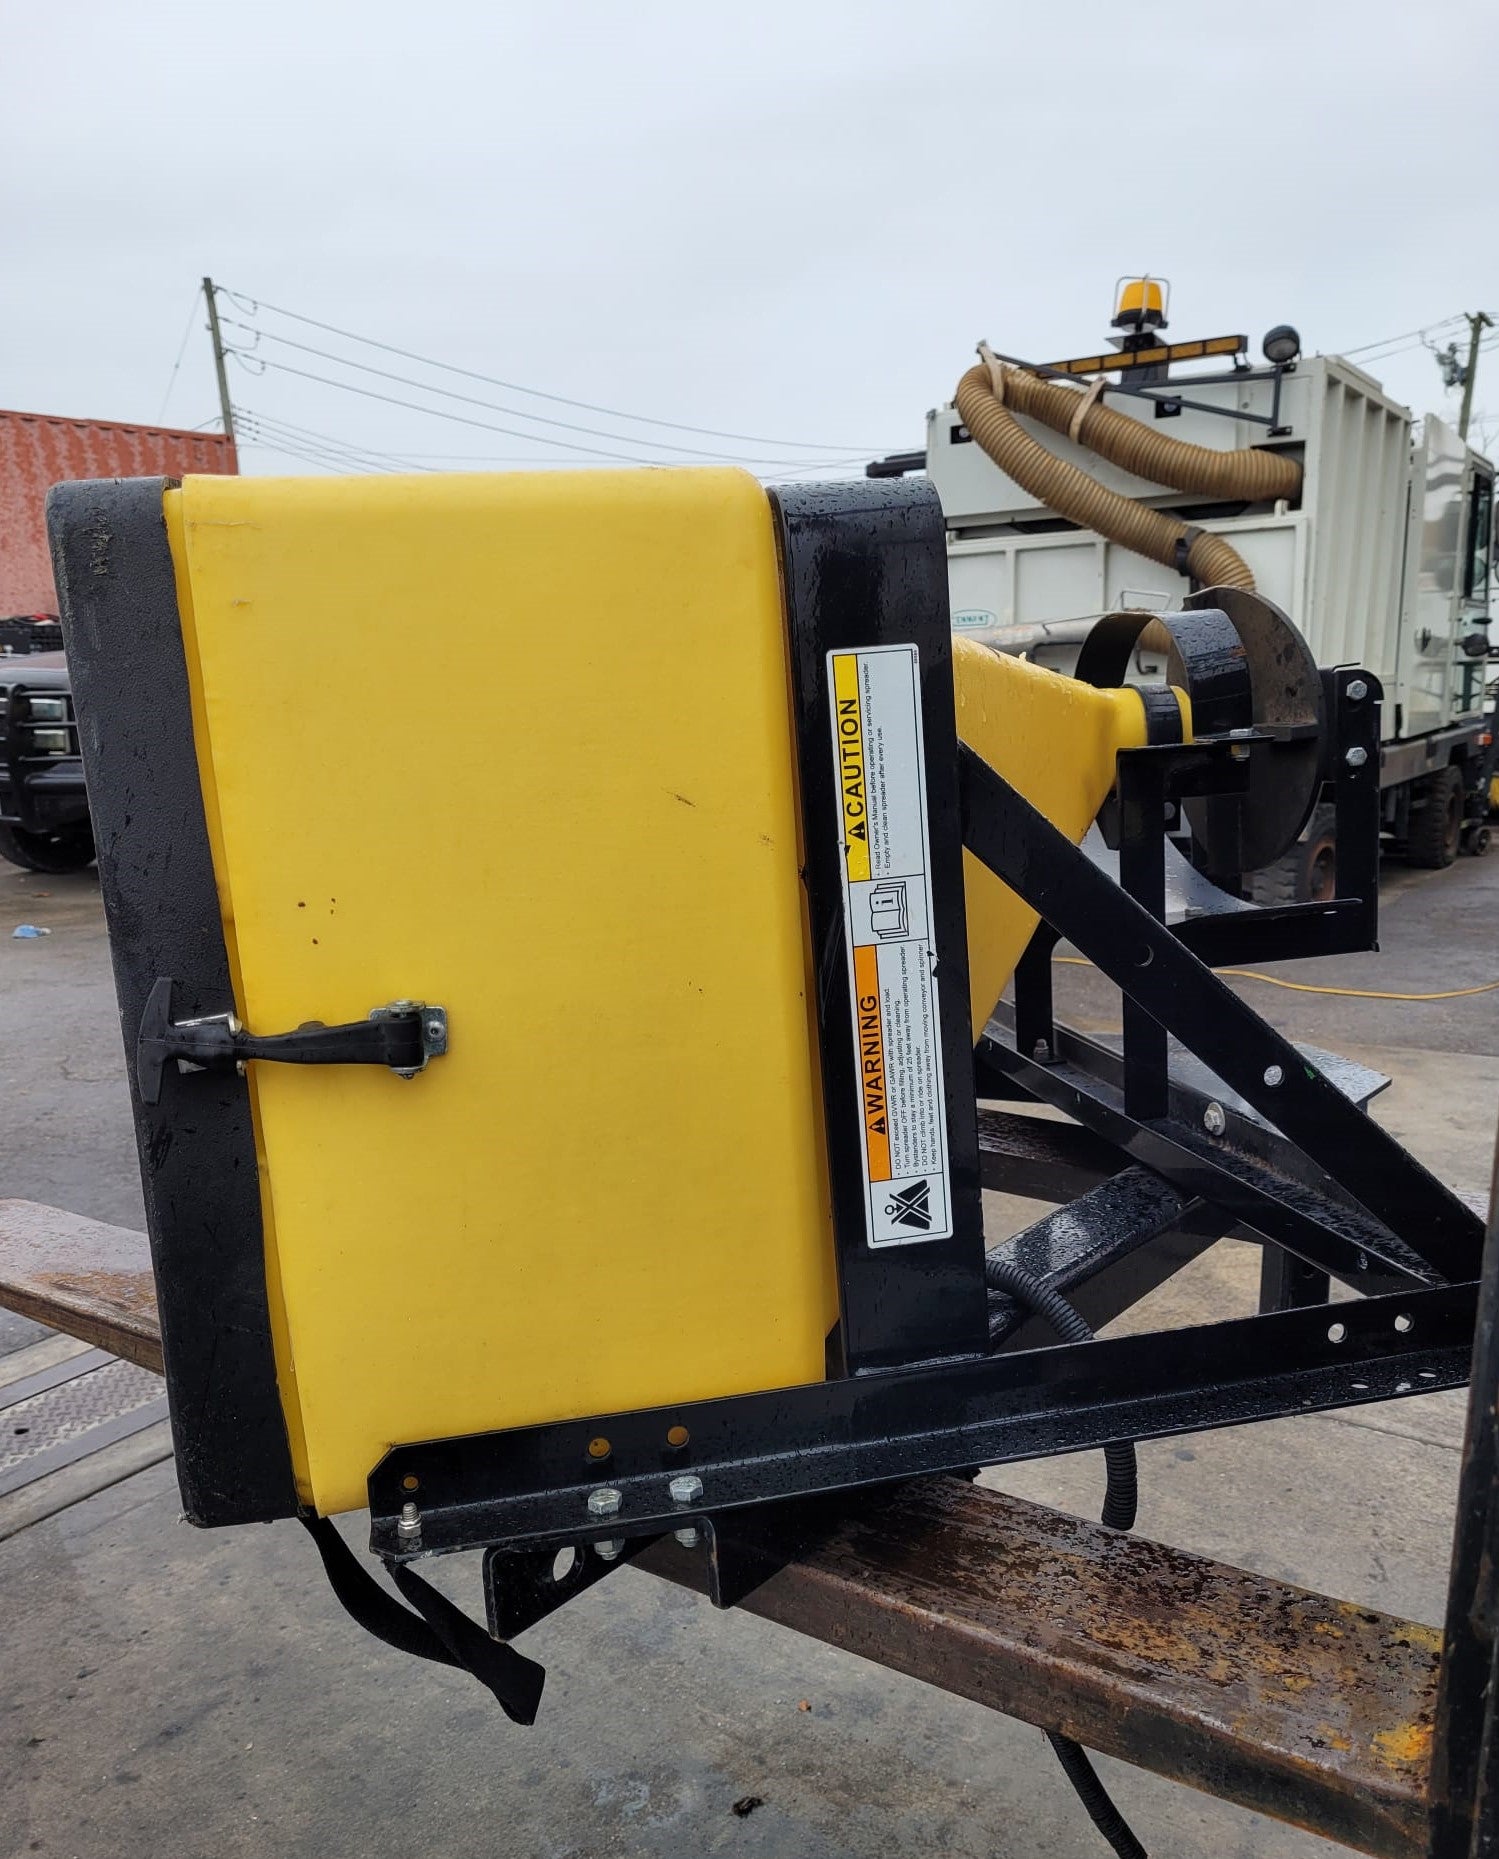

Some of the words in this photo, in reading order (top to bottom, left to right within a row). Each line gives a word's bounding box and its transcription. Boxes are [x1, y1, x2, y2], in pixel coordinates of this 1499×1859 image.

[862, 661, 870, 693] spreader.
[864, 695, 872, 726] servicing
[839, 699, 863, 817] CAUTION
[867, 737, 875, 769] operating
[879, 780, 888, 810] spreader
[899, 944, 907, 974] spreader.
[901, 976, 909, 1006] operating
[919, 982, 928, 1012] conveyor
[893, 998, 901, 1027] cleaning.
[921, 1013, 929, 1037] moving
[885, 1018, 894, 1046] spreader
[904, 1024, 912, 1041] away
[859, 994, 883, 1114] WARNING
[896, 1037, 904, 1066] adjusting
[906, 1056, 912, 1064] 25
[914, 1046, 922, 1074] spreader.
[918, 1076, 922, 1084] on
[925, 1072, 933, 1097] clothing
[909, 1109, 917, 1122] stay
[894, 1158, 901, 1169] DO
[911, 1131, 919, 1167] Bystanders
[921, 1154, 927, 1165] DO
